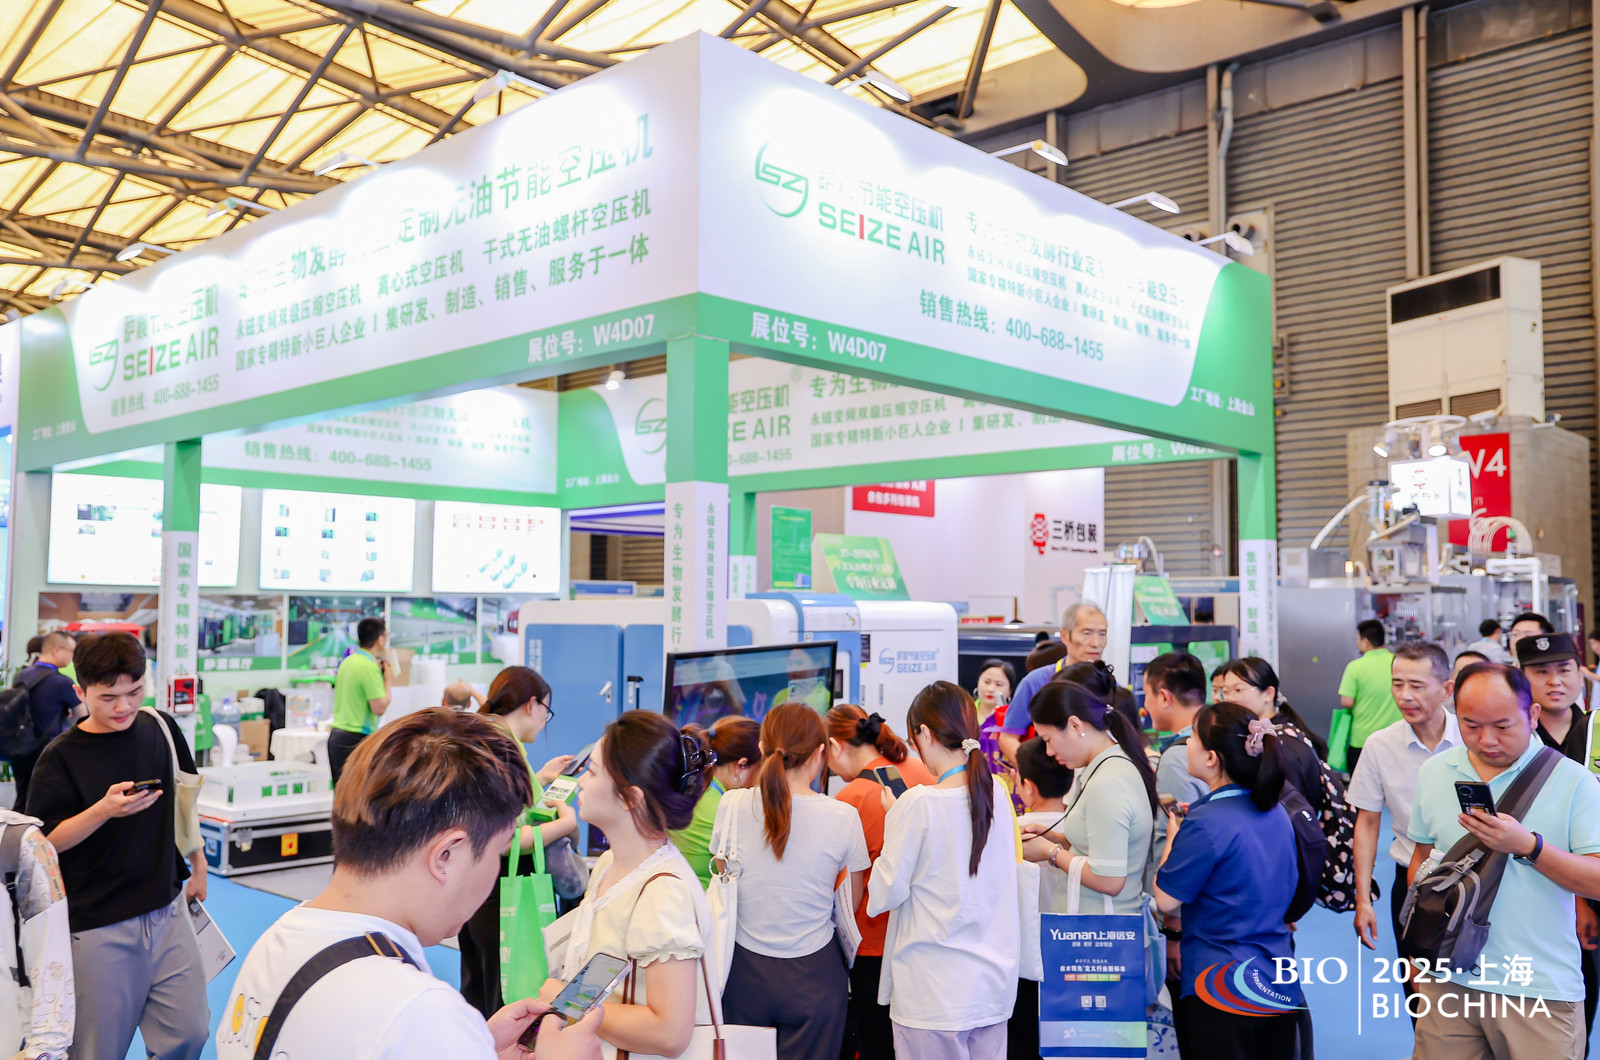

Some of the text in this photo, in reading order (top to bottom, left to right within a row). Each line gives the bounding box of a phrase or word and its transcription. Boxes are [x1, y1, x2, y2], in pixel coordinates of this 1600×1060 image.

[482, 188, 652, 265] 干式无油螺杆空压机
[818, 201, 945, 265] SEIZE AIR
[593, 314, 655, 347] W4D07
[919, 288, 1104, 362] 销售热线： 400-688-1455
[122, 326, 220, 382] SEIZE AIR
[235, 316, 366, 372] 国家专精特新小巨人企业
[828, 330, 887, 363] W4D07
[752, 415, 791, 440] AIR
[809, 397, 947, 427] 永磁变频双级压缩空压机
[810, 411, 951, 448] 国家专精特新小巨人企业
[329, 449, 432, 471] 400-688-1455
[1053, 519, 1097, 542] 三桥包装
[671, 502, 683, 653] 专为生物发酵行
[896, 663, 937, 673] SEIZE AIR
[1049, 929, 1097, 941] Yuanan
